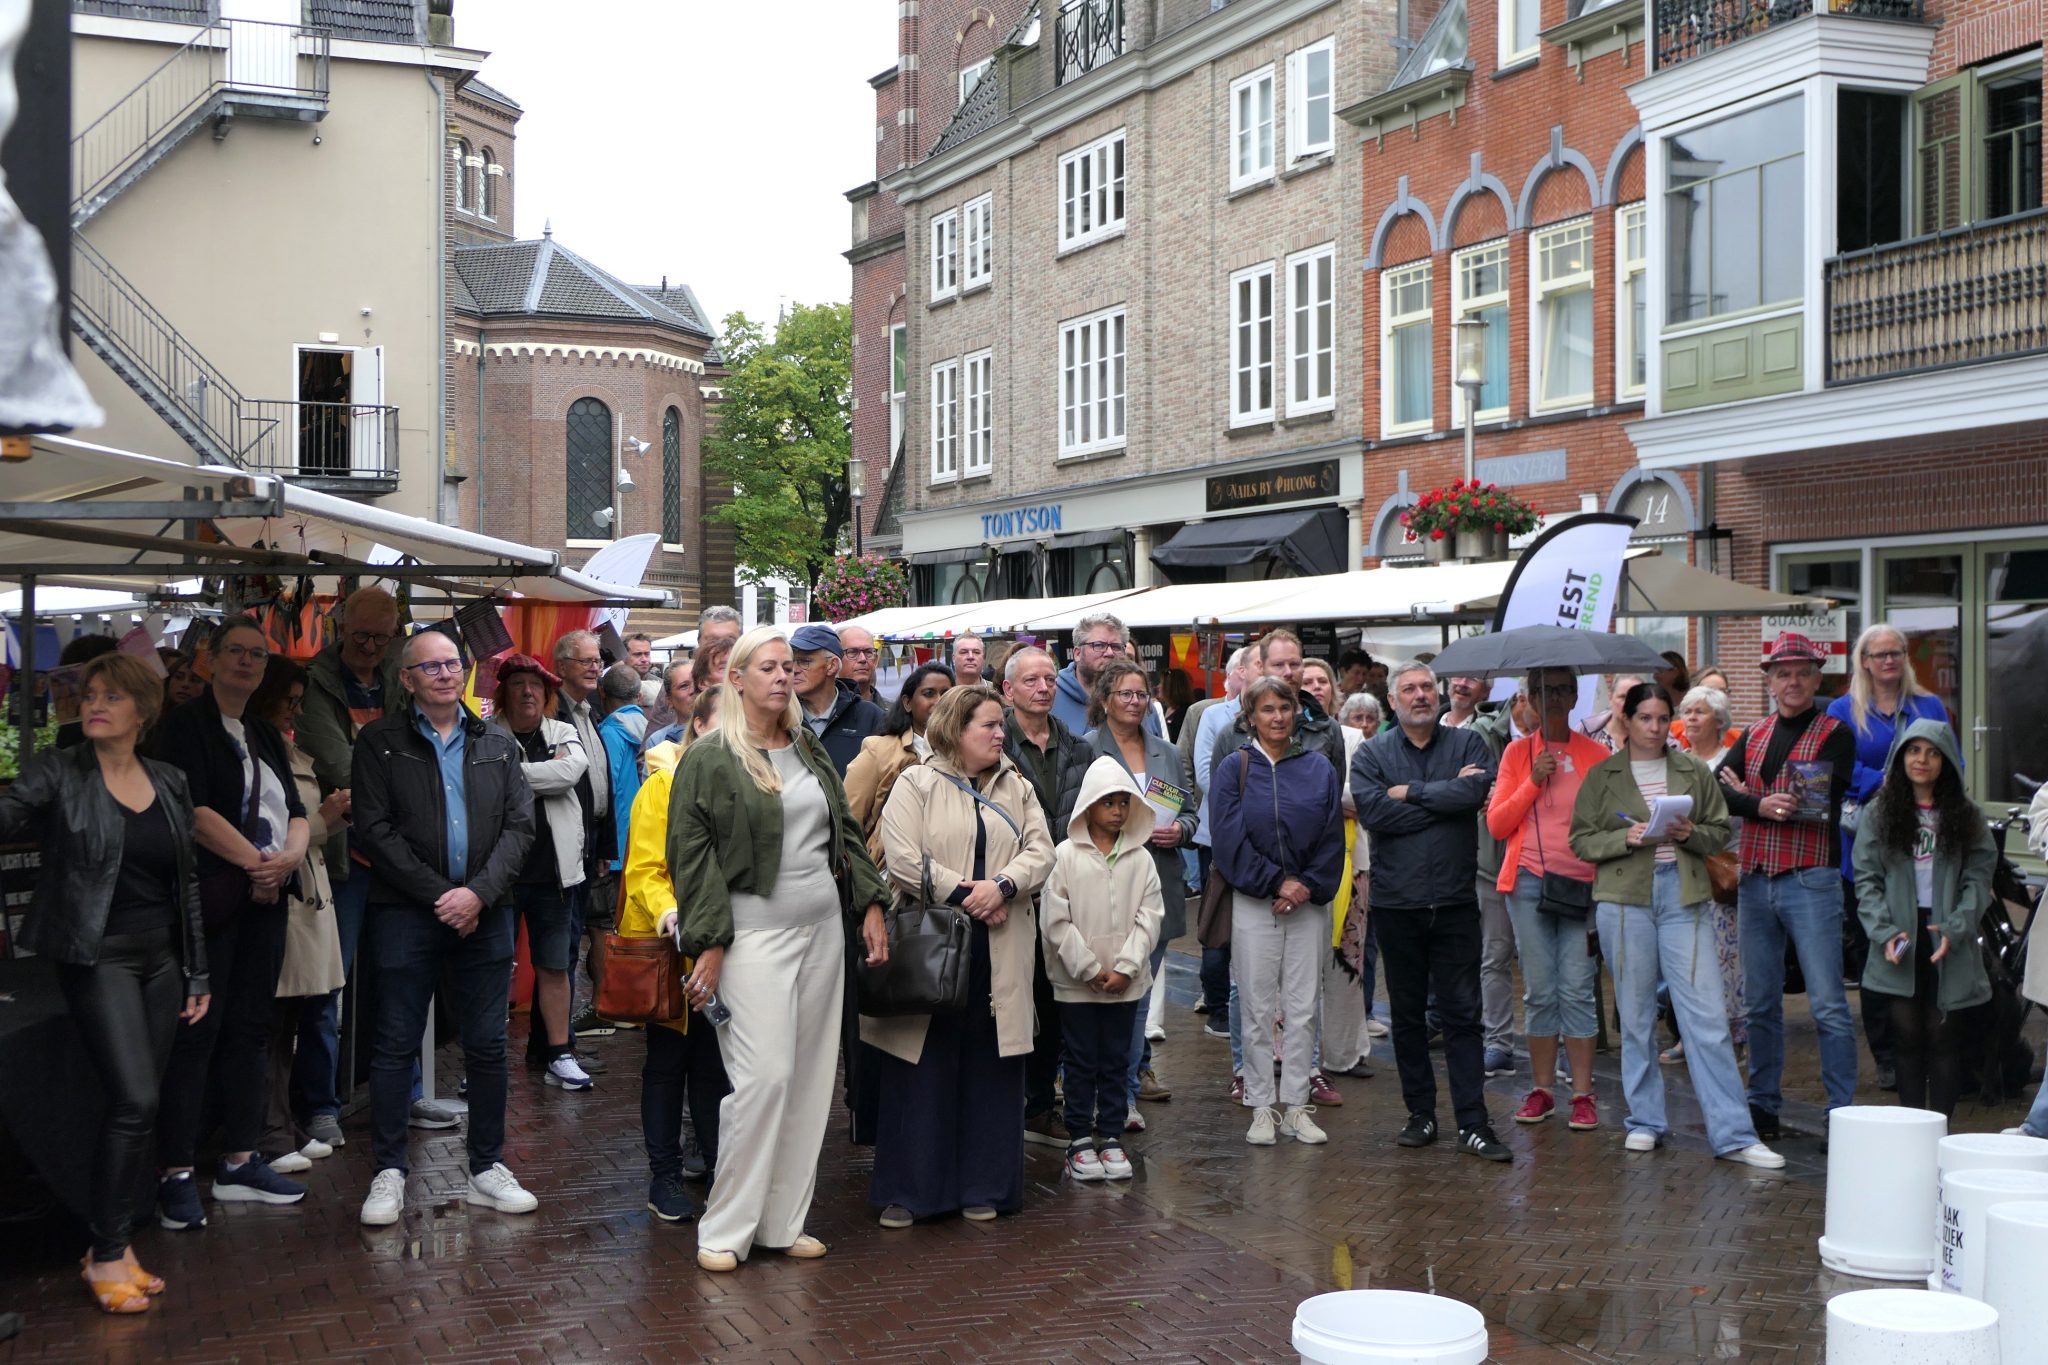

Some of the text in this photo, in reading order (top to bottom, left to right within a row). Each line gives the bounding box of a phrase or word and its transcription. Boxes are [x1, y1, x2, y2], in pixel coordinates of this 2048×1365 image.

[1226, 475, 1316, 499] NAILS BY PHUONG
[1642, 493, 1669, 525] 14
[981, 504, 1062, 538] TONYSON
[1767, 616, 1836, 628] QUADYCK
[1152, 779, 1179, 795] CULTUUR
[1163, 789, 1185, 805] MARKT
